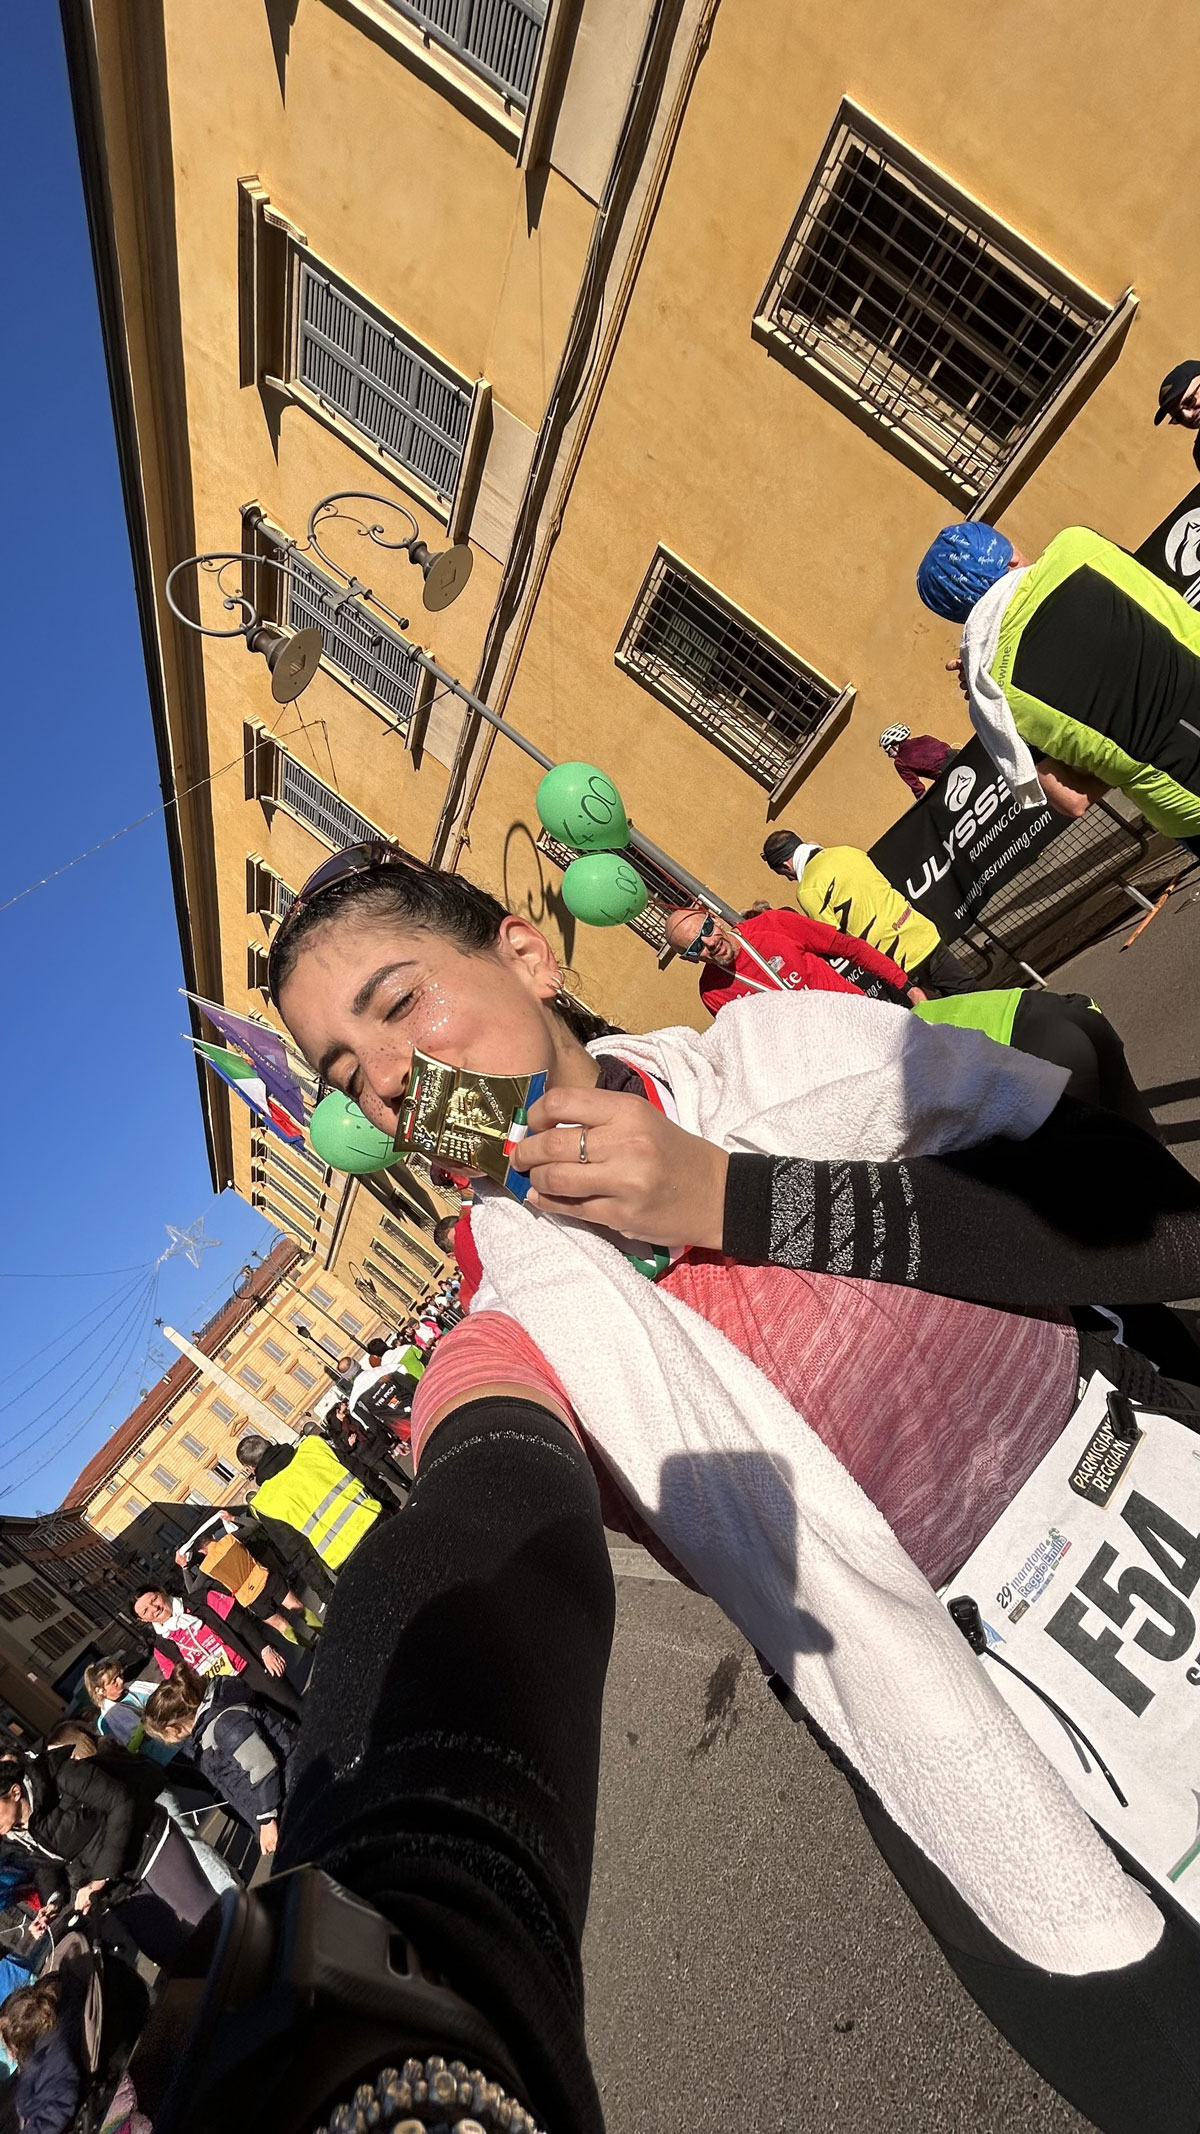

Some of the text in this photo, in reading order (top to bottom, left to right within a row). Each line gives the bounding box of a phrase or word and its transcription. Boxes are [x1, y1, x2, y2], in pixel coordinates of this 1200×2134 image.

[996, 646, 1012, 690] ewline
[562, 776, 617, 846] 4:00
[906, 775, 1014, 899] ULYSSE
[969, 801, 1025, 862] RUNNING CO
[954, 810, 1053, 920] www.ulyssesrunning.com
[1073, 1415, 1115, 1489] PARMIGIAN
[1011, 1542, 1047, 1590] maratona
[1018, 1562, 1048, 1598] Reggio
[1041, 1535, 1068, 1566] Emilia
[1044, 1489, 1200, 1718] F54
